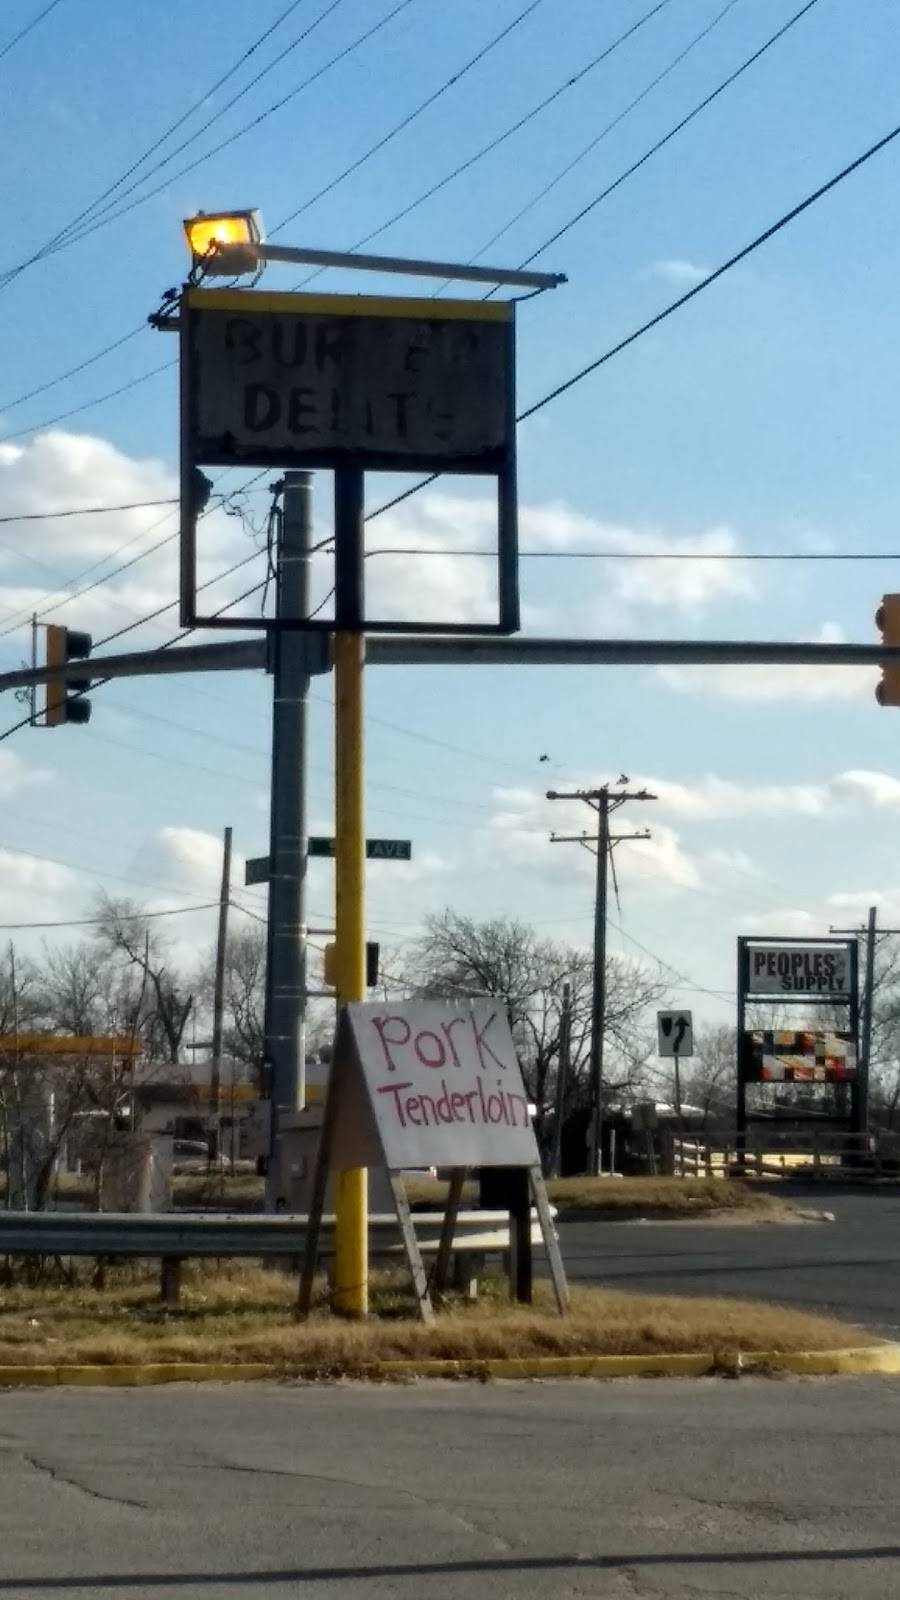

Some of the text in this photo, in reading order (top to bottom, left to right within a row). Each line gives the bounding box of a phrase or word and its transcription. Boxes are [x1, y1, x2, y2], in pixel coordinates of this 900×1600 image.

[372, 843, 405, 858] AVE
[753, 952, 836, 976] PEOPLES
[780, 975, 845, 991] SUPPLY
[376, 1076, 529, 1128] Tenderloin
